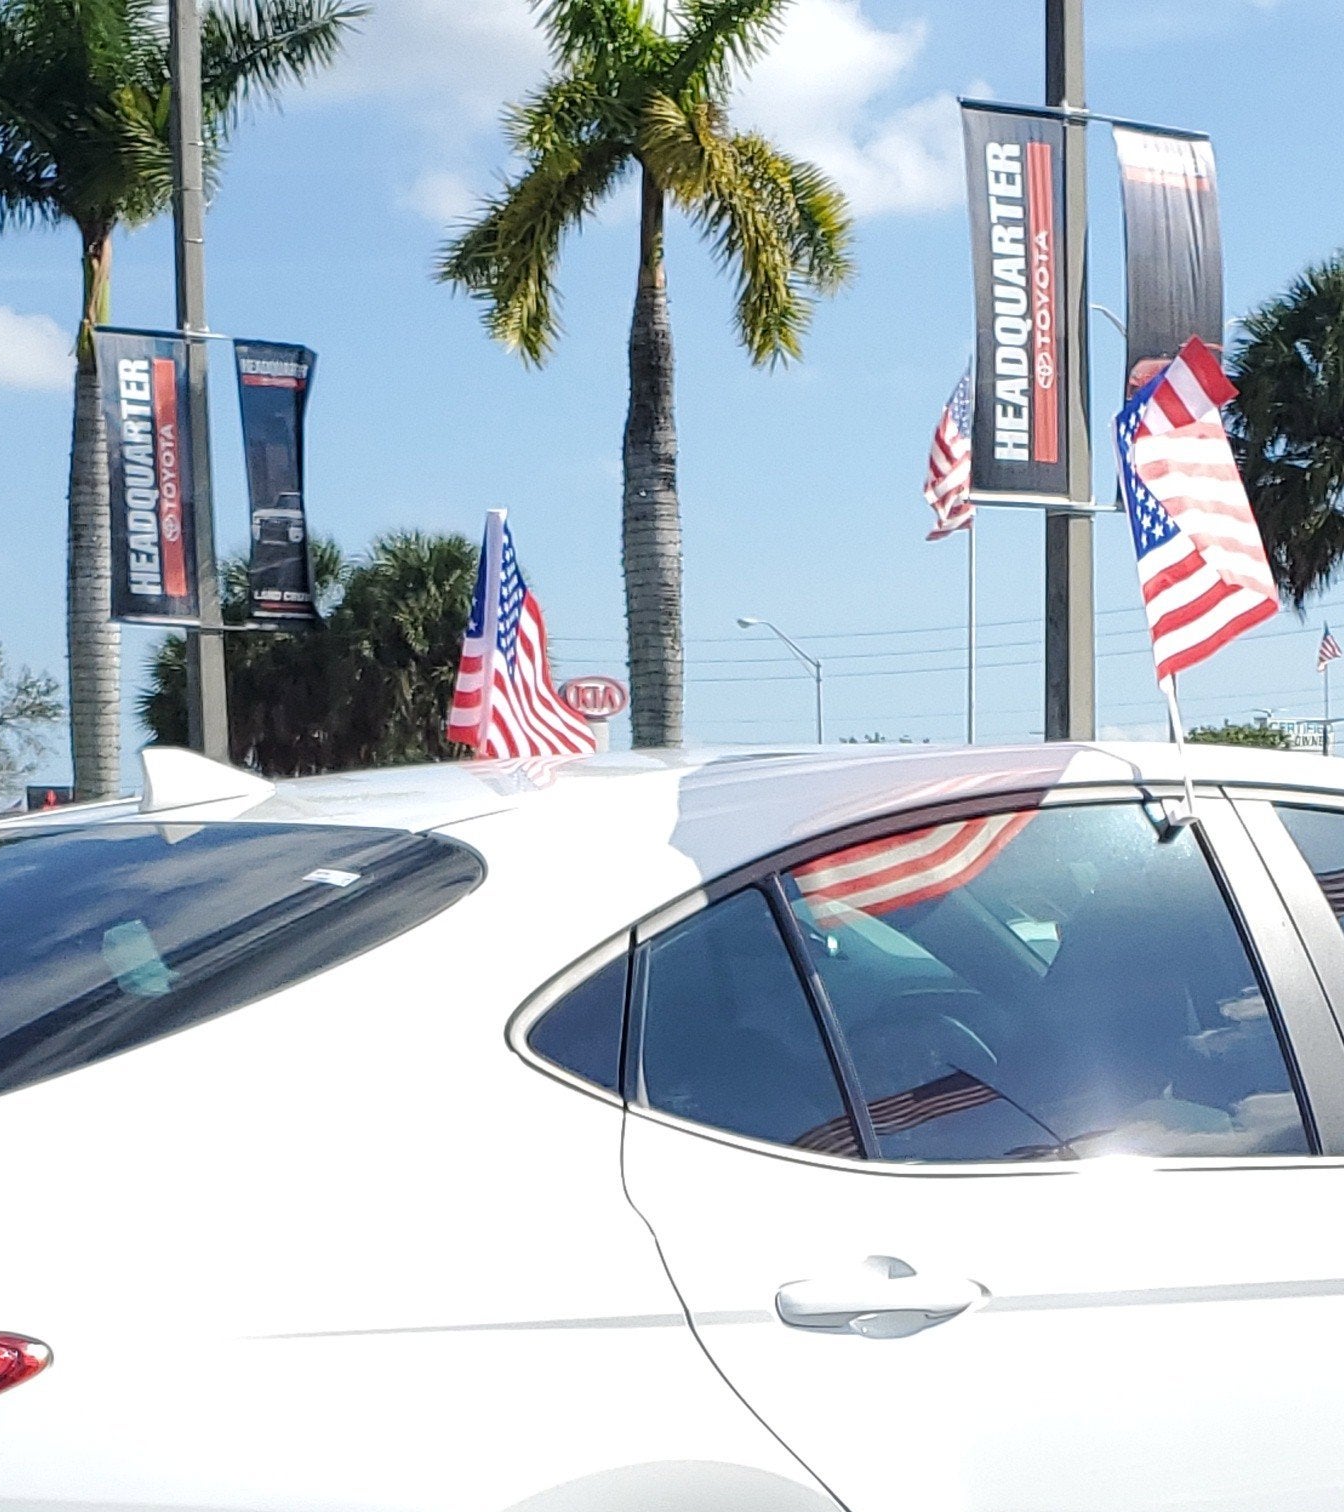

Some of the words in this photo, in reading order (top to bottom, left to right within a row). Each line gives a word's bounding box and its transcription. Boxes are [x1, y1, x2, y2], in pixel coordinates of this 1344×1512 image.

[986, 142, 1033, 461] HEADQUARTER
[1035, 230, 1053, 349] TOYOTA
[118, 358, 163, 595] HEADQUARTER
[157, 424, 181, 507] TOYOTA
[575, 685, 615, 709] KIA
[1295, 735, 1330, 748] OWNE
